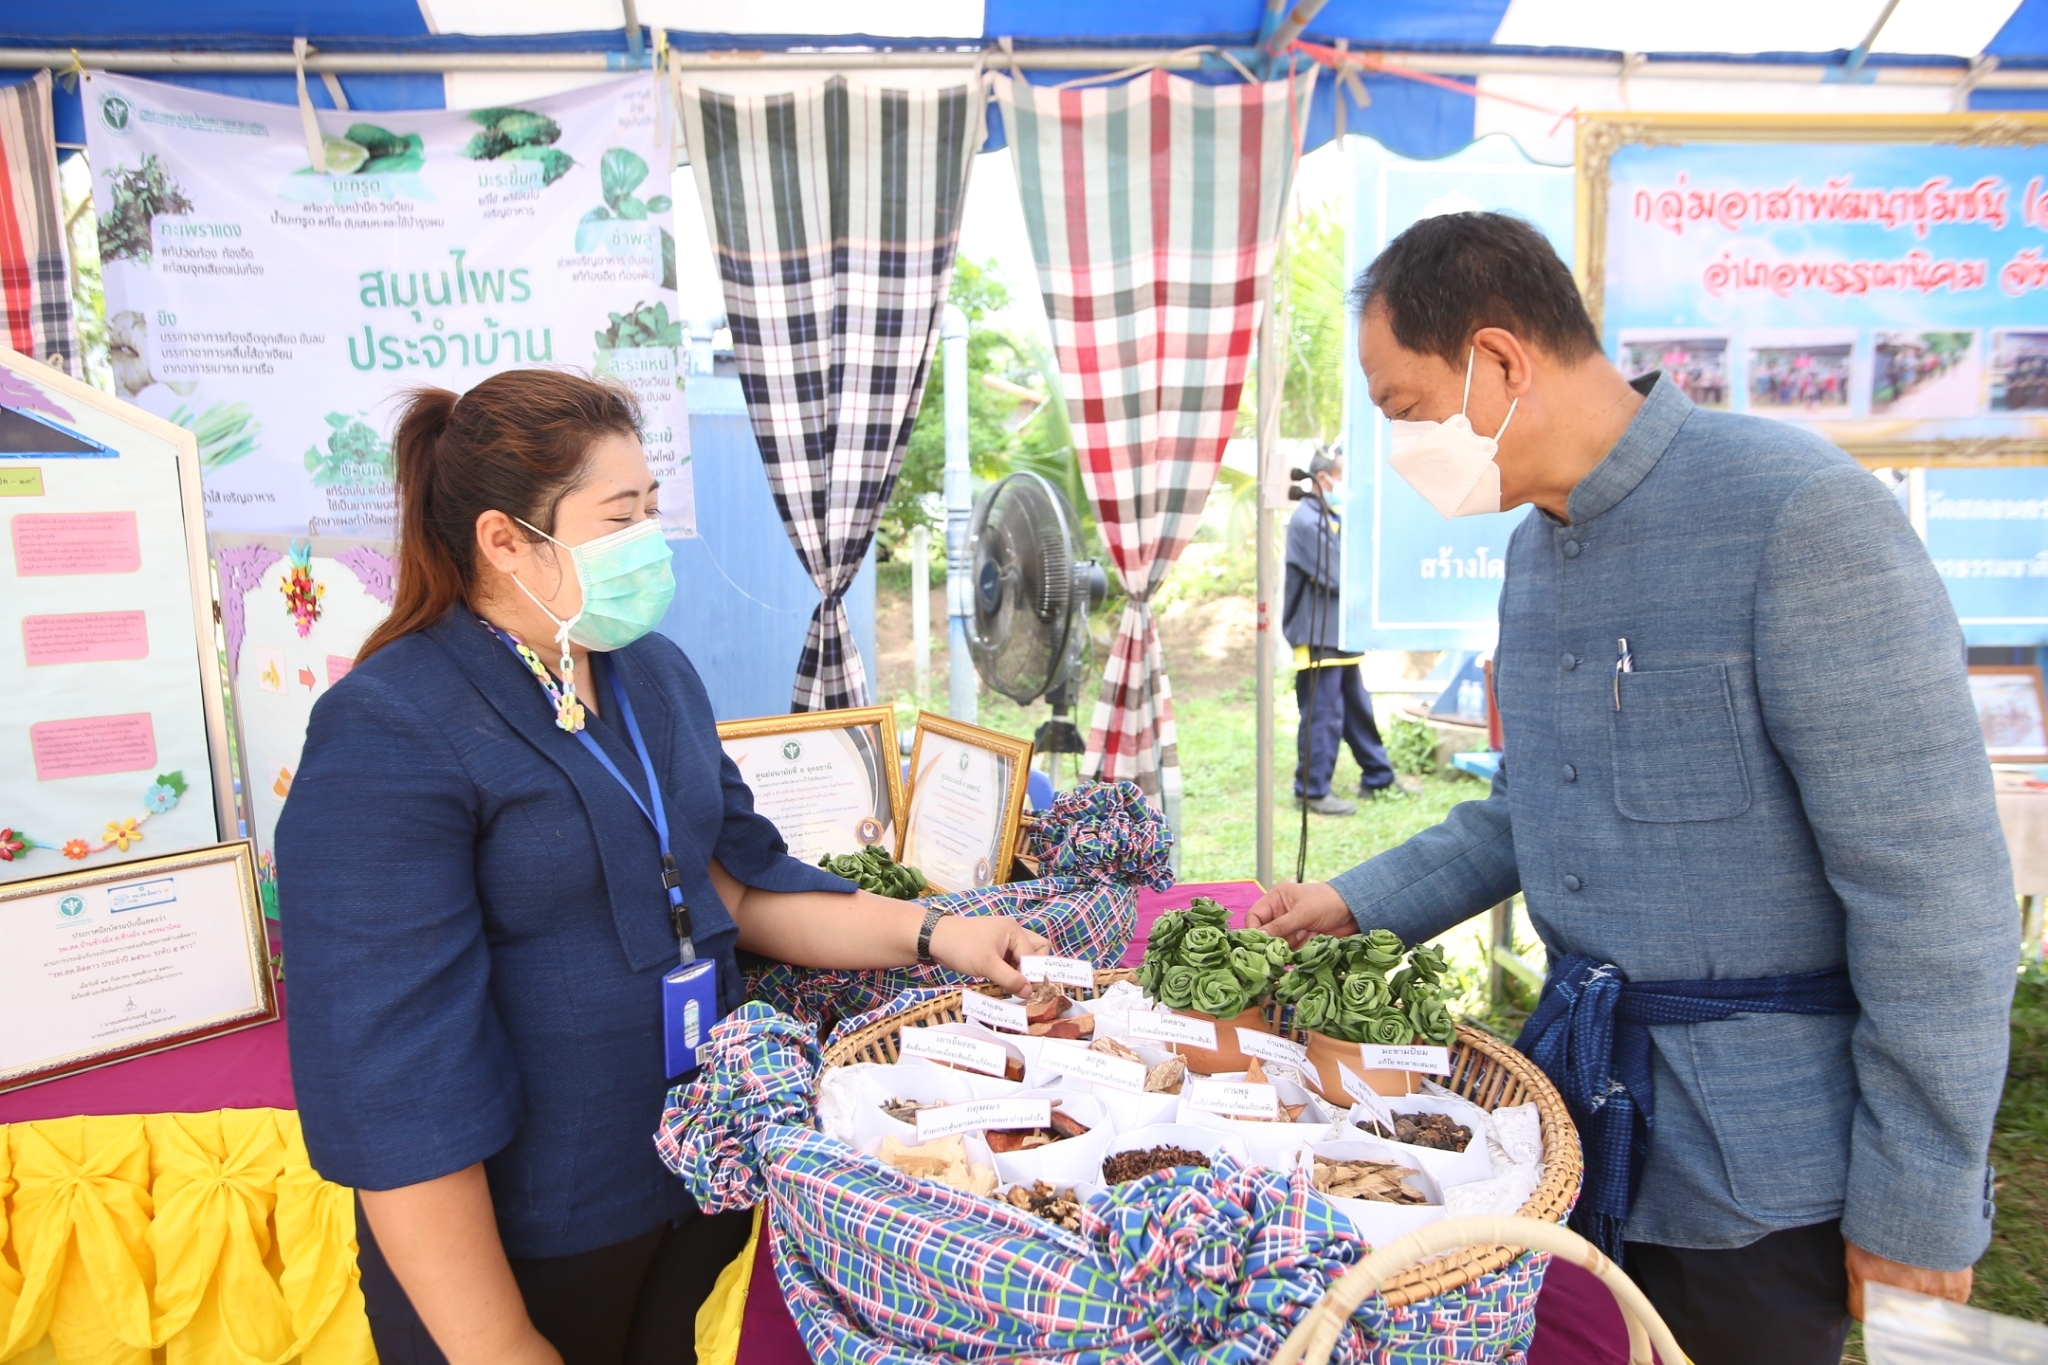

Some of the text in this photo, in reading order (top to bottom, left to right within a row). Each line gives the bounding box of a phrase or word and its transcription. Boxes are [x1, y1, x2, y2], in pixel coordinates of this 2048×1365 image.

[478, 163, 538, 188] มะระขี้นก
[333, 179, 381, 199] มะกรูด
[379, 200, 414, 214] วิงเวียน
[483, 206, 535, 218] เจริญอาหาร
[1633, 173, 2008, 237] กลุ่มอาสาพัฒนาชุมชน
[161, 223, 242, 238] กะเพราแดง
[612, 229, 653, 251] ช้าพลู
[161, 245, 254, 260] แก้ปวดท้อง ท้องอืด
[572, 270, 617, 282] แก้ท้องอืด
[359, 248, 532, 323] สมุนไพร
[157, 309, 177, 327] ขิง
[160, 330, 326, 347] บรรเทาอาการท้องอืดจุกเสียด ขับลม
[348, 316, 553, 371] ประจำบ้าน
[161, 345, 293, 361] บรรเทาอาการคลื่นไส้อาเจียน
[162, 362, 275, 375] จากอาการเมารถ เมาเรือ
[610, 354, 669, 373] สะระแหน่
[646, 391, 671, 402] ขับลม
[325, 482, 366, 496] แก้ร้อนใน
[222, 491, 276, 506] เจริญอาหาร
[1420, 545, 1504, 579] สร้างโด
[71, 915, 167, 939] ประกาศนียบัตรฉบับนี้แสดงว่า
[1160, 1013, 1186, 1028] โคคลาน
[1381, 1047, 1428, 1057] มะขามป้อม
[1086, 1055, 1107, 1068] มะตูม
[1377, 1057, 1395, 1066] แก้ไอ
[1223, 1087, 1249, 1100] กานพลู
[966, 1103, 1000, 1114] กฤษณา
